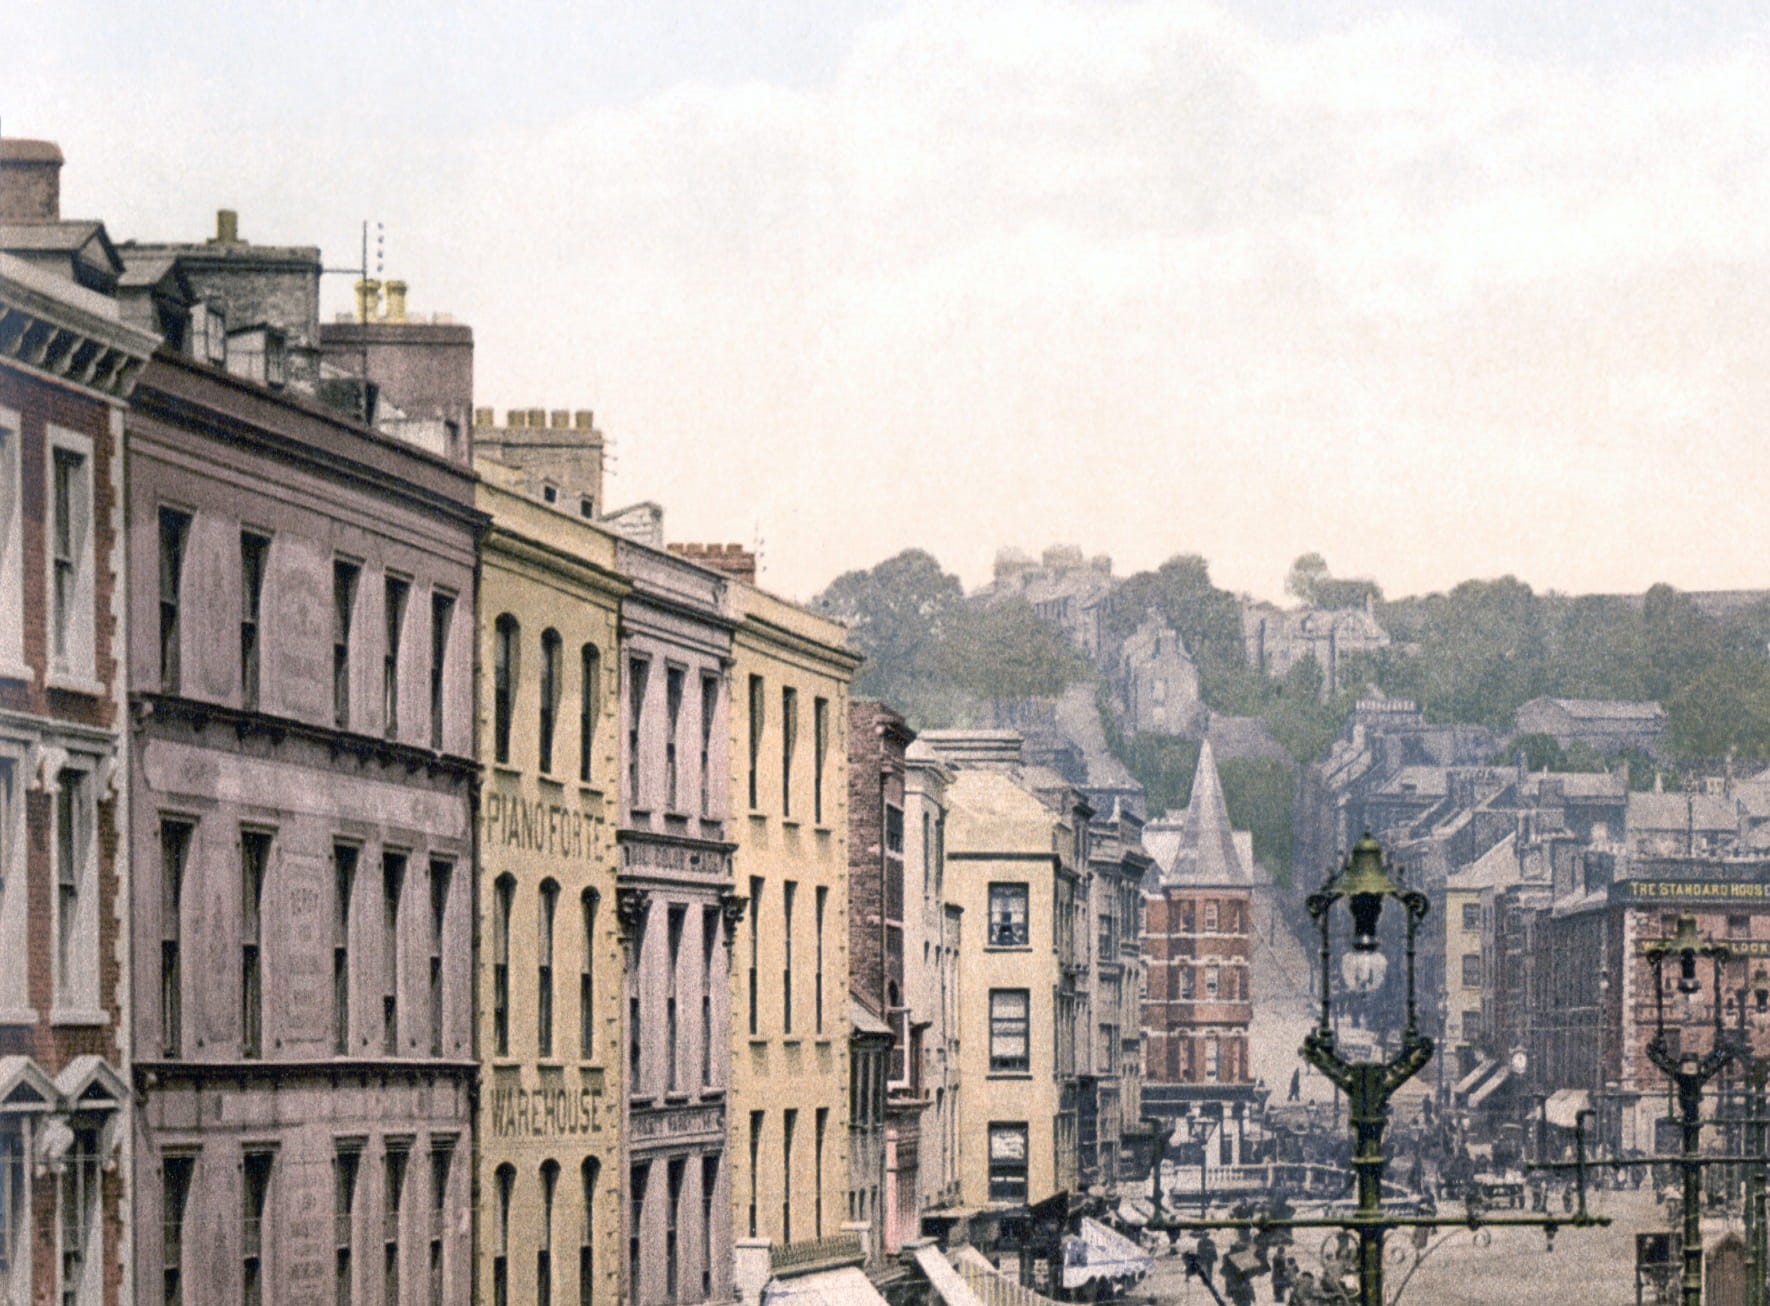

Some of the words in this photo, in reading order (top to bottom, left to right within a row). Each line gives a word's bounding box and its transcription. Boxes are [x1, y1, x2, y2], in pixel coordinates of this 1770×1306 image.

[1659, 883, 1729, 896] STANDARD
[1731, 883, 1770, 897] HOUSE
[490, 1087, 602, 1137] WAREHOUSE
